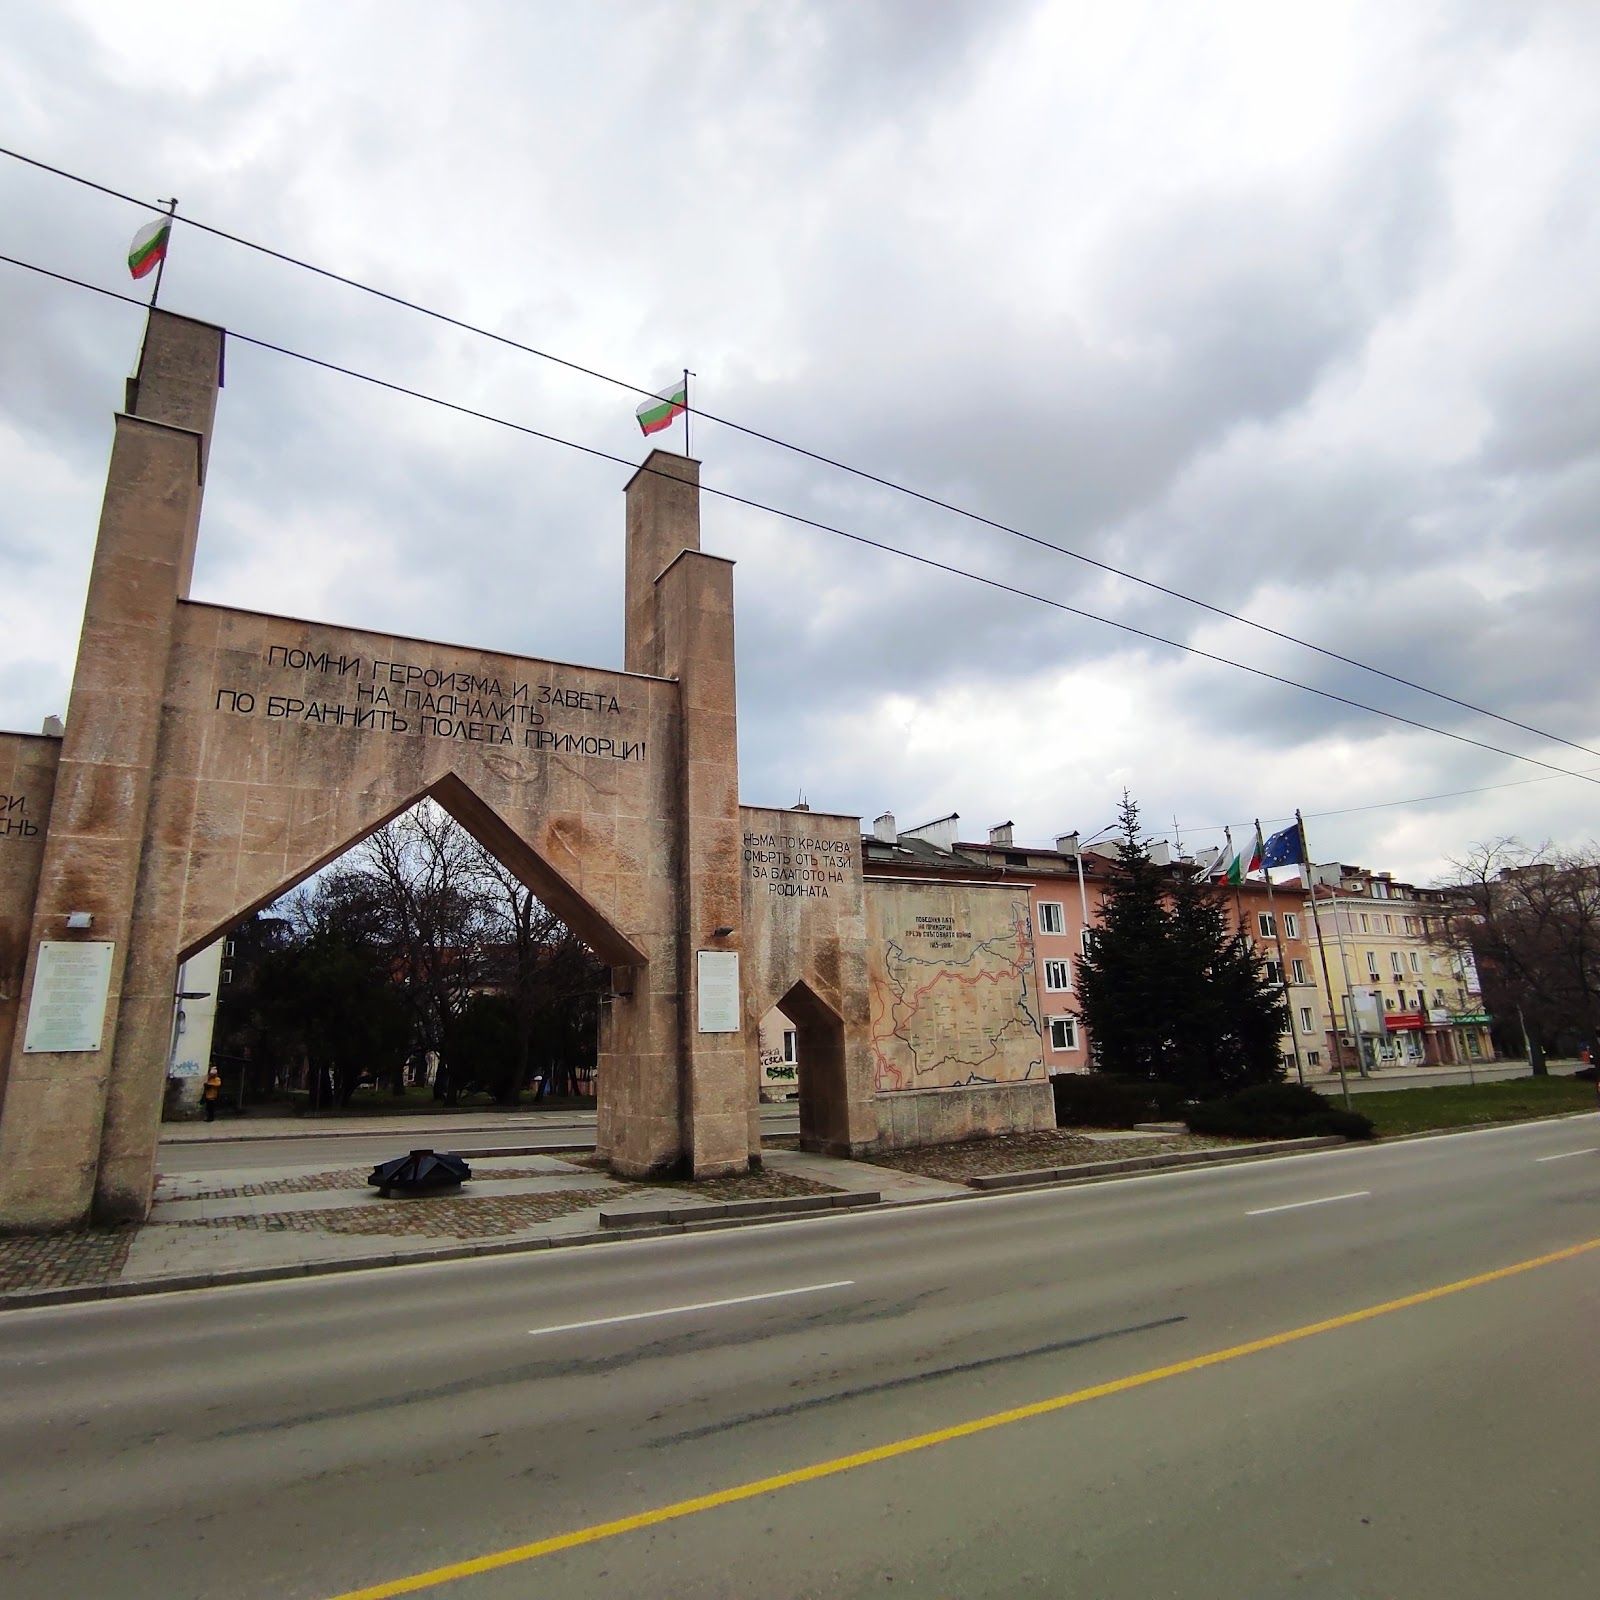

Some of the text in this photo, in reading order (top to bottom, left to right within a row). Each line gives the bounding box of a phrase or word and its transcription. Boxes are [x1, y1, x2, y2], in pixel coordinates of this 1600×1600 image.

[268, 645, 621, 715] ПОМНИ ГЕРОИЗМА И ЗАВЕТА
[357, 682, 391, 706] НА
[216, 689, 255, 713] ПО
[420, 715, 514, 745] ПОЛЕТА
[525, 729, 646, 761] ПРИМОРЦИ!
[780, 836, 796, 848] ПО
[798, 837, 851, 853] КРАСИВА
[752, 866, 844, 883] ЗА БЛАГОТО НА
